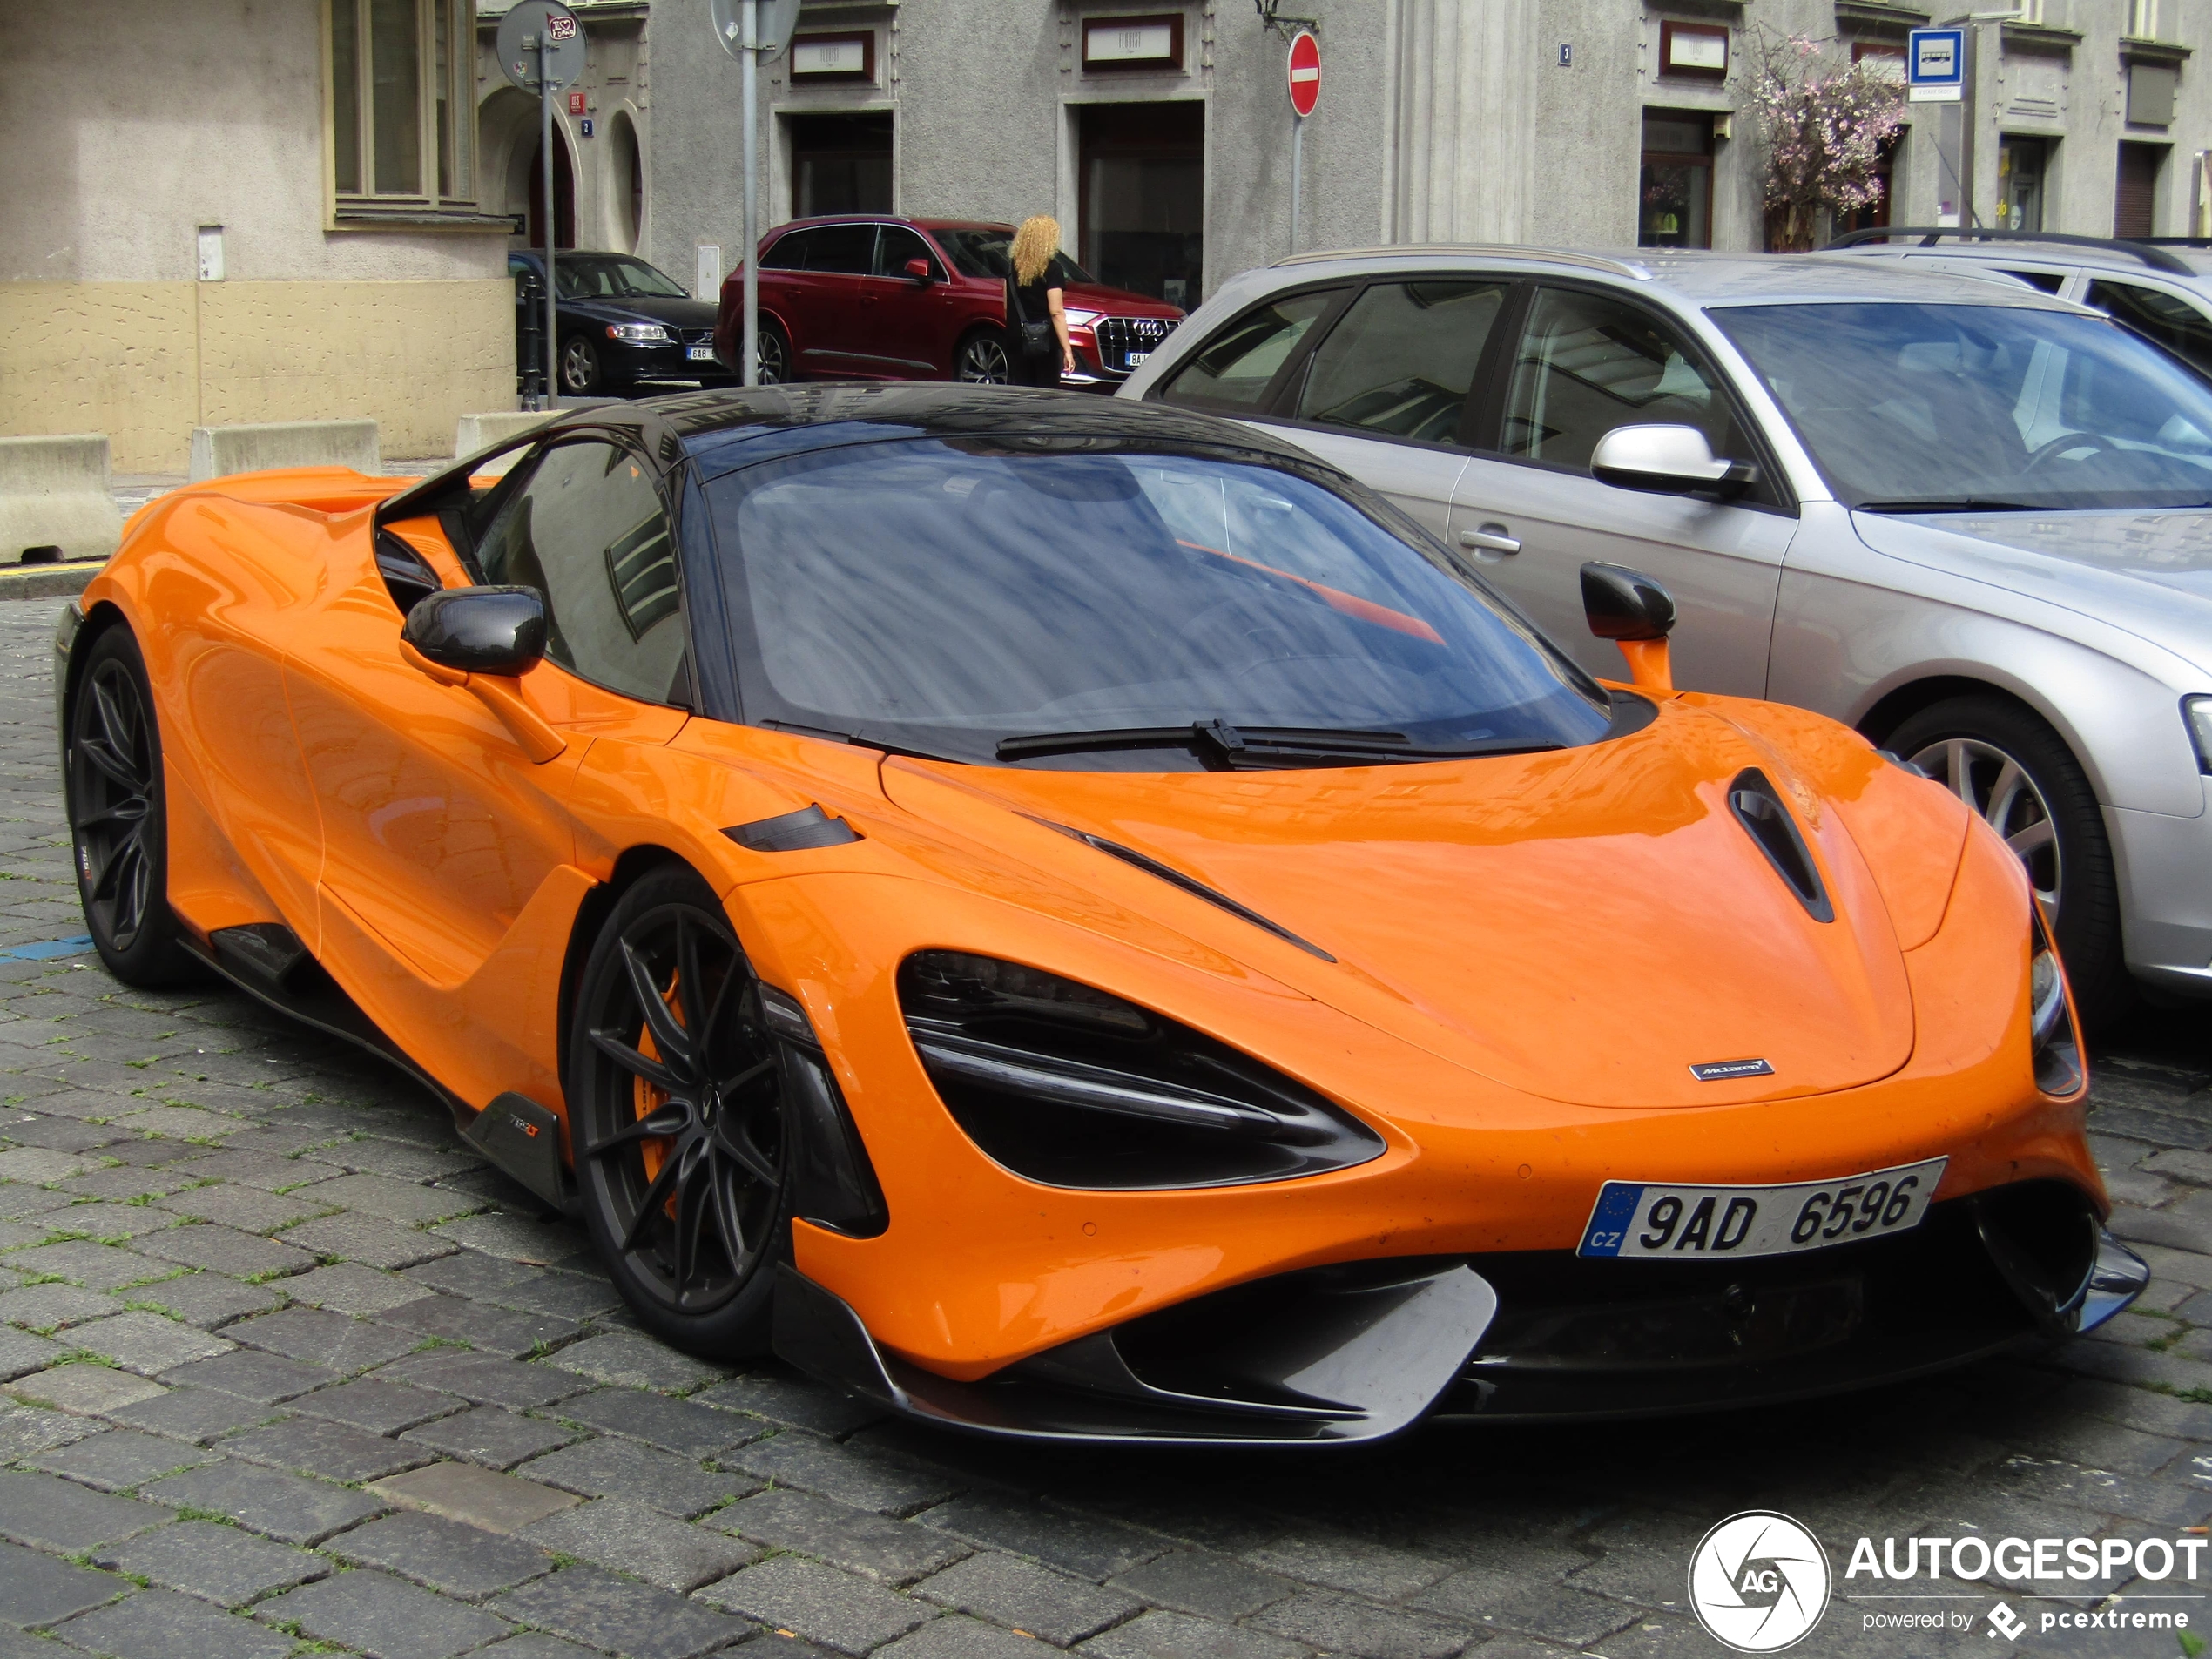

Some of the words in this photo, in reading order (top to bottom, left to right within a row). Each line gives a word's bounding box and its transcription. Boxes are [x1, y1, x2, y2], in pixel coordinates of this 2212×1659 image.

[1564, 47, 1568, 60] 3
[584, 123, 589, 133] 2
[1702, 1063, 1761, 1075] McLaren
[1639, 1196, 1758, 1251] 9AD
[1791, 1175, 1919, 1244] 6596
[1590, 1231, 1618, 1248] CZ
